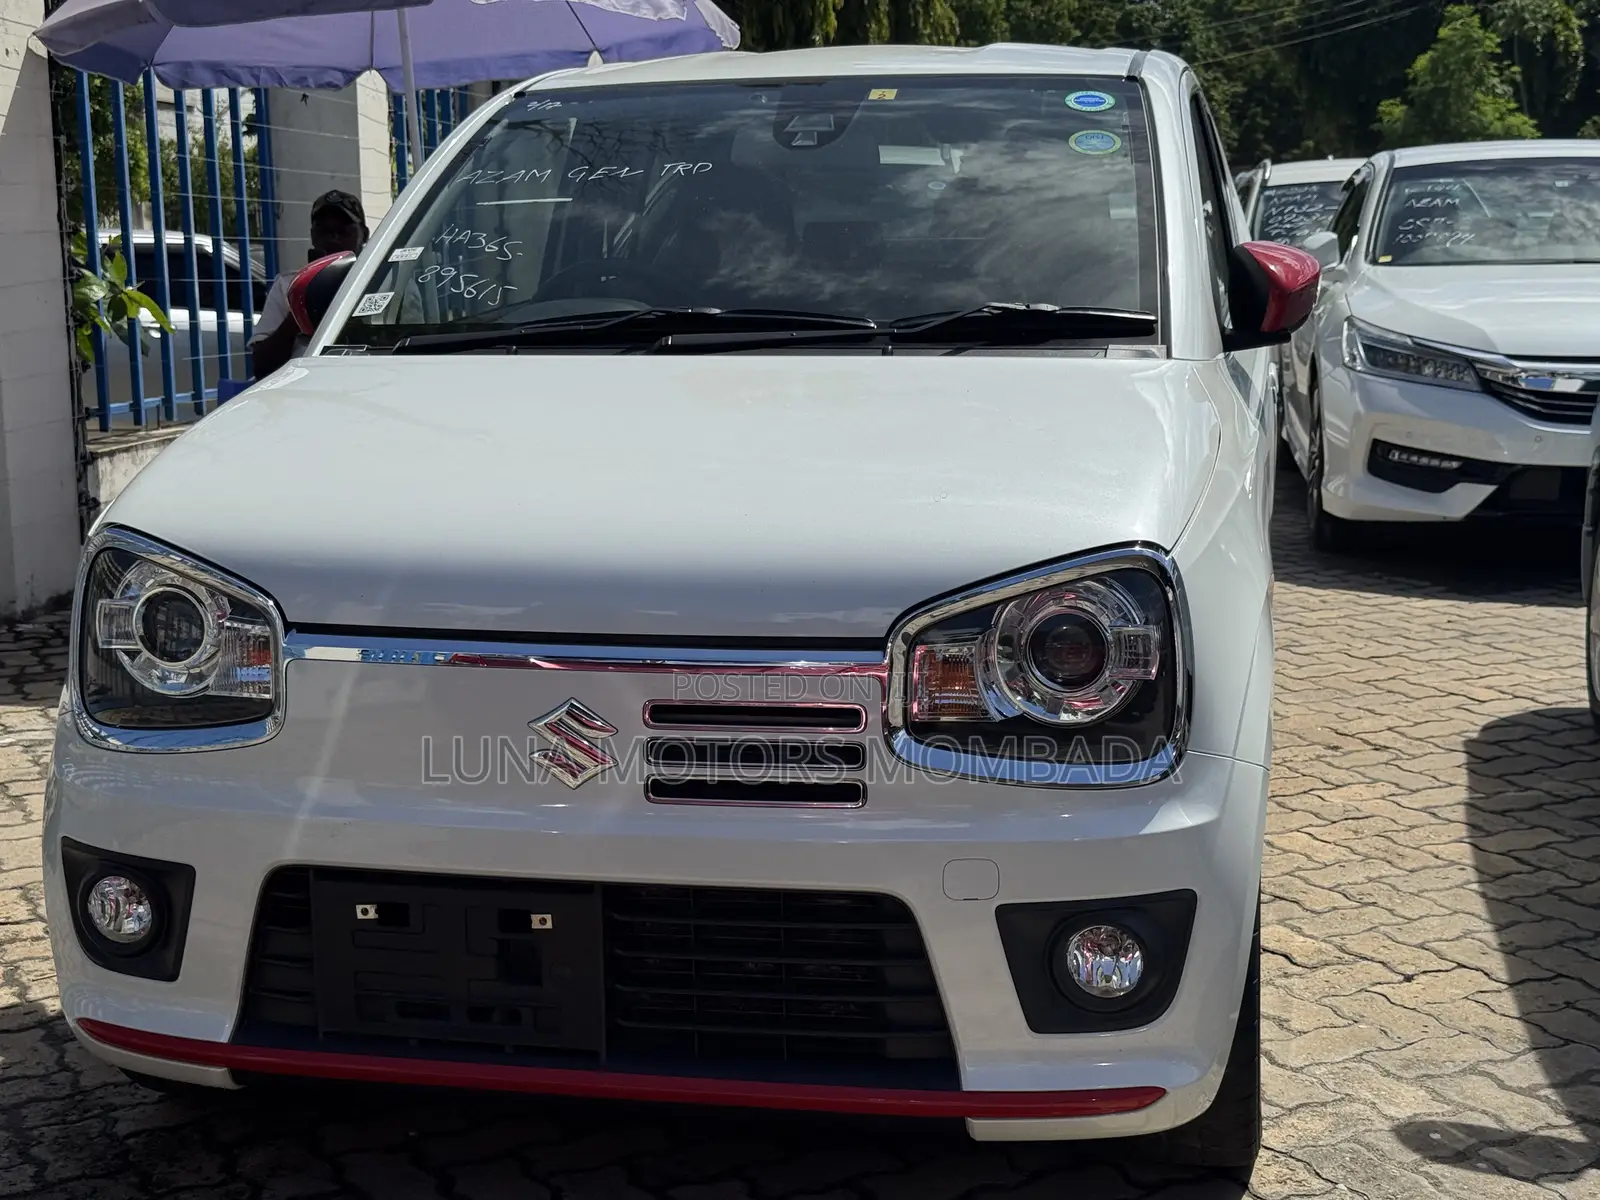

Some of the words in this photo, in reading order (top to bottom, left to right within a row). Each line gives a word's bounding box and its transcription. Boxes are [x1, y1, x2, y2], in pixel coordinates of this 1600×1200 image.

[456, 169, 552, 185] AZAM
[568, 166, 644, 183] GEN
[418, 265, 518, 306] 895615
